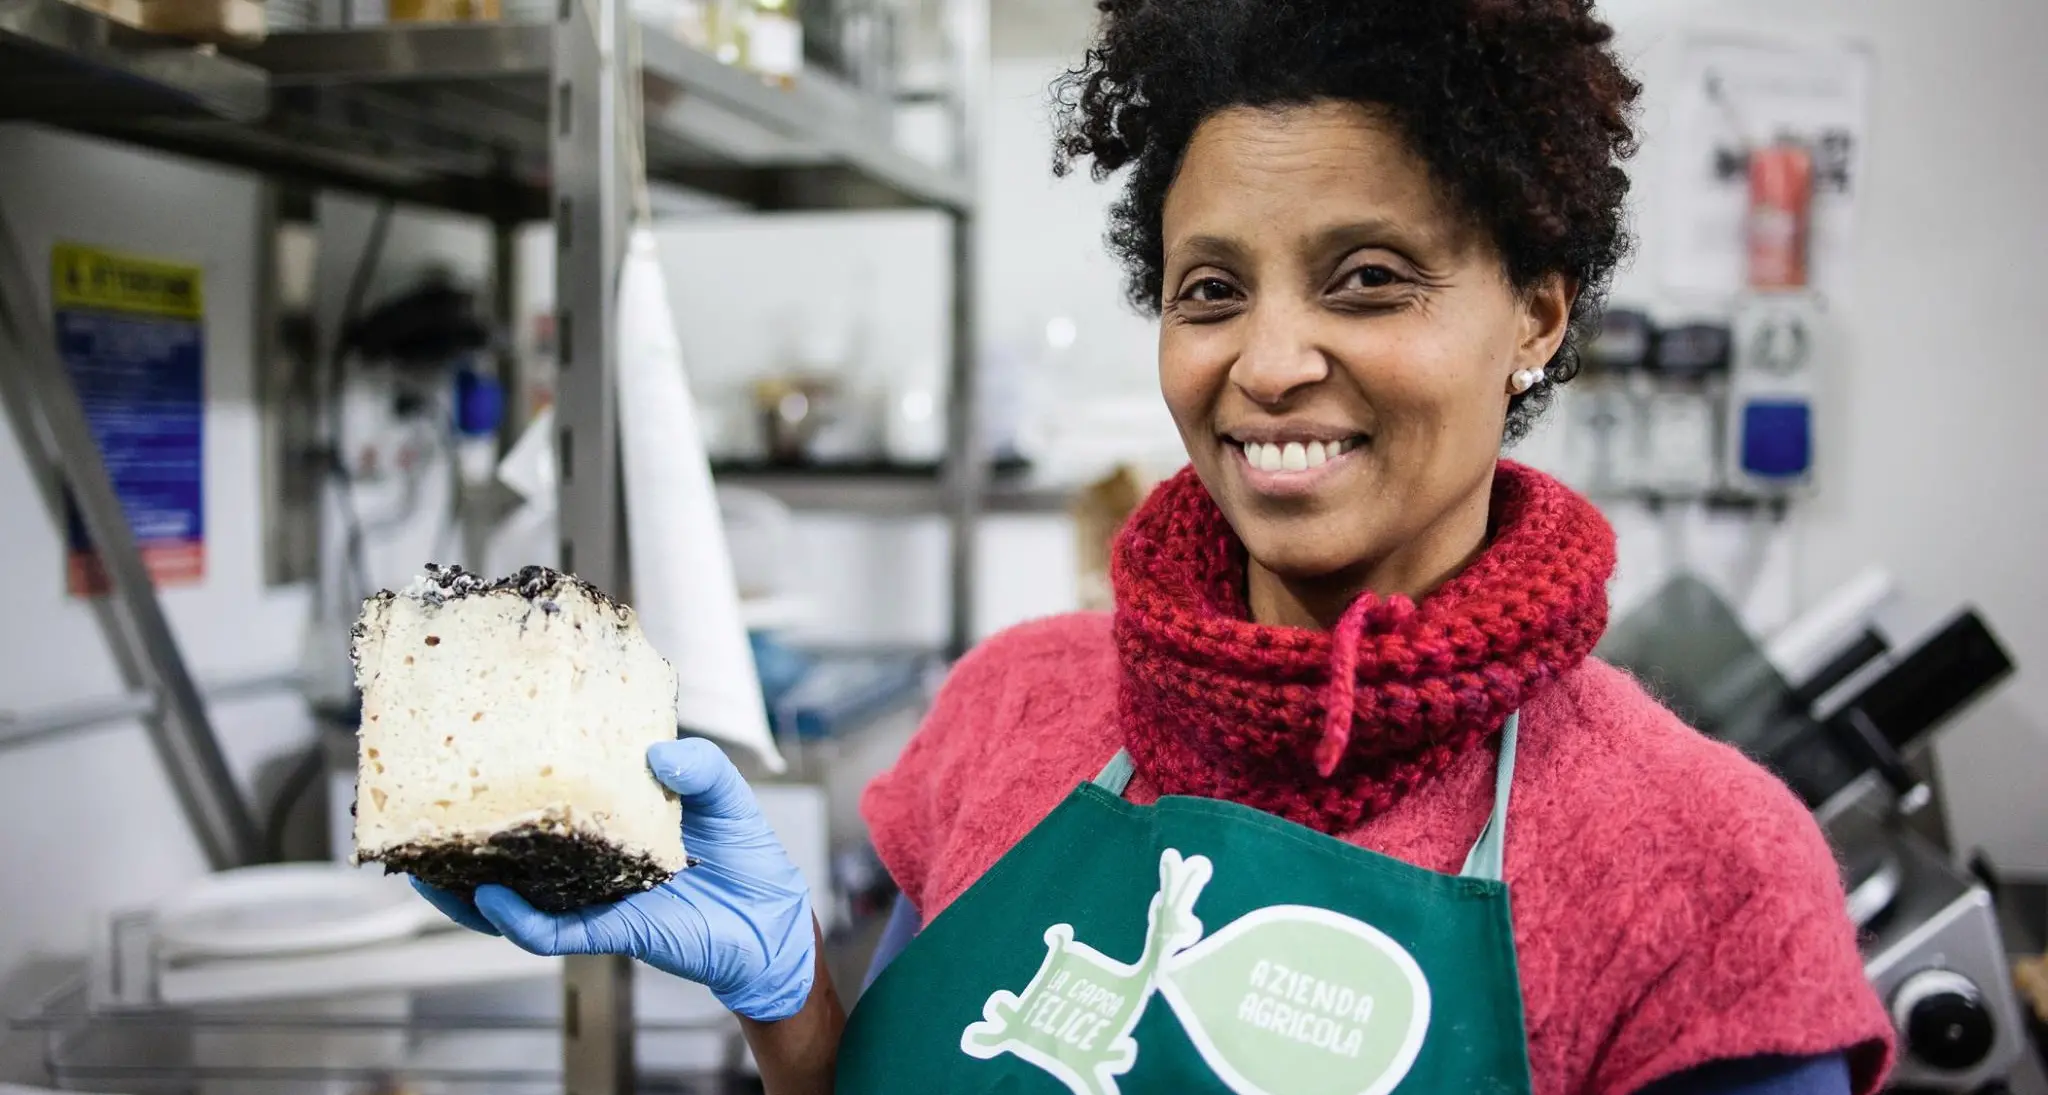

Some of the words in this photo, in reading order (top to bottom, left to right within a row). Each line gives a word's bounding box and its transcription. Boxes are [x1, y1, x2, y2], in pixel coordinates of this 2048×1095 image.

[1023, 990, 1112, 1050] FELICE
[1047, 967, 1070, 991] LA
[1068, 978, 1125, 1017] CAPRA
[1250, 959, 1373, 1023] AZIENDA
[1237, 991, 1362, 1057] AGRICOLA
